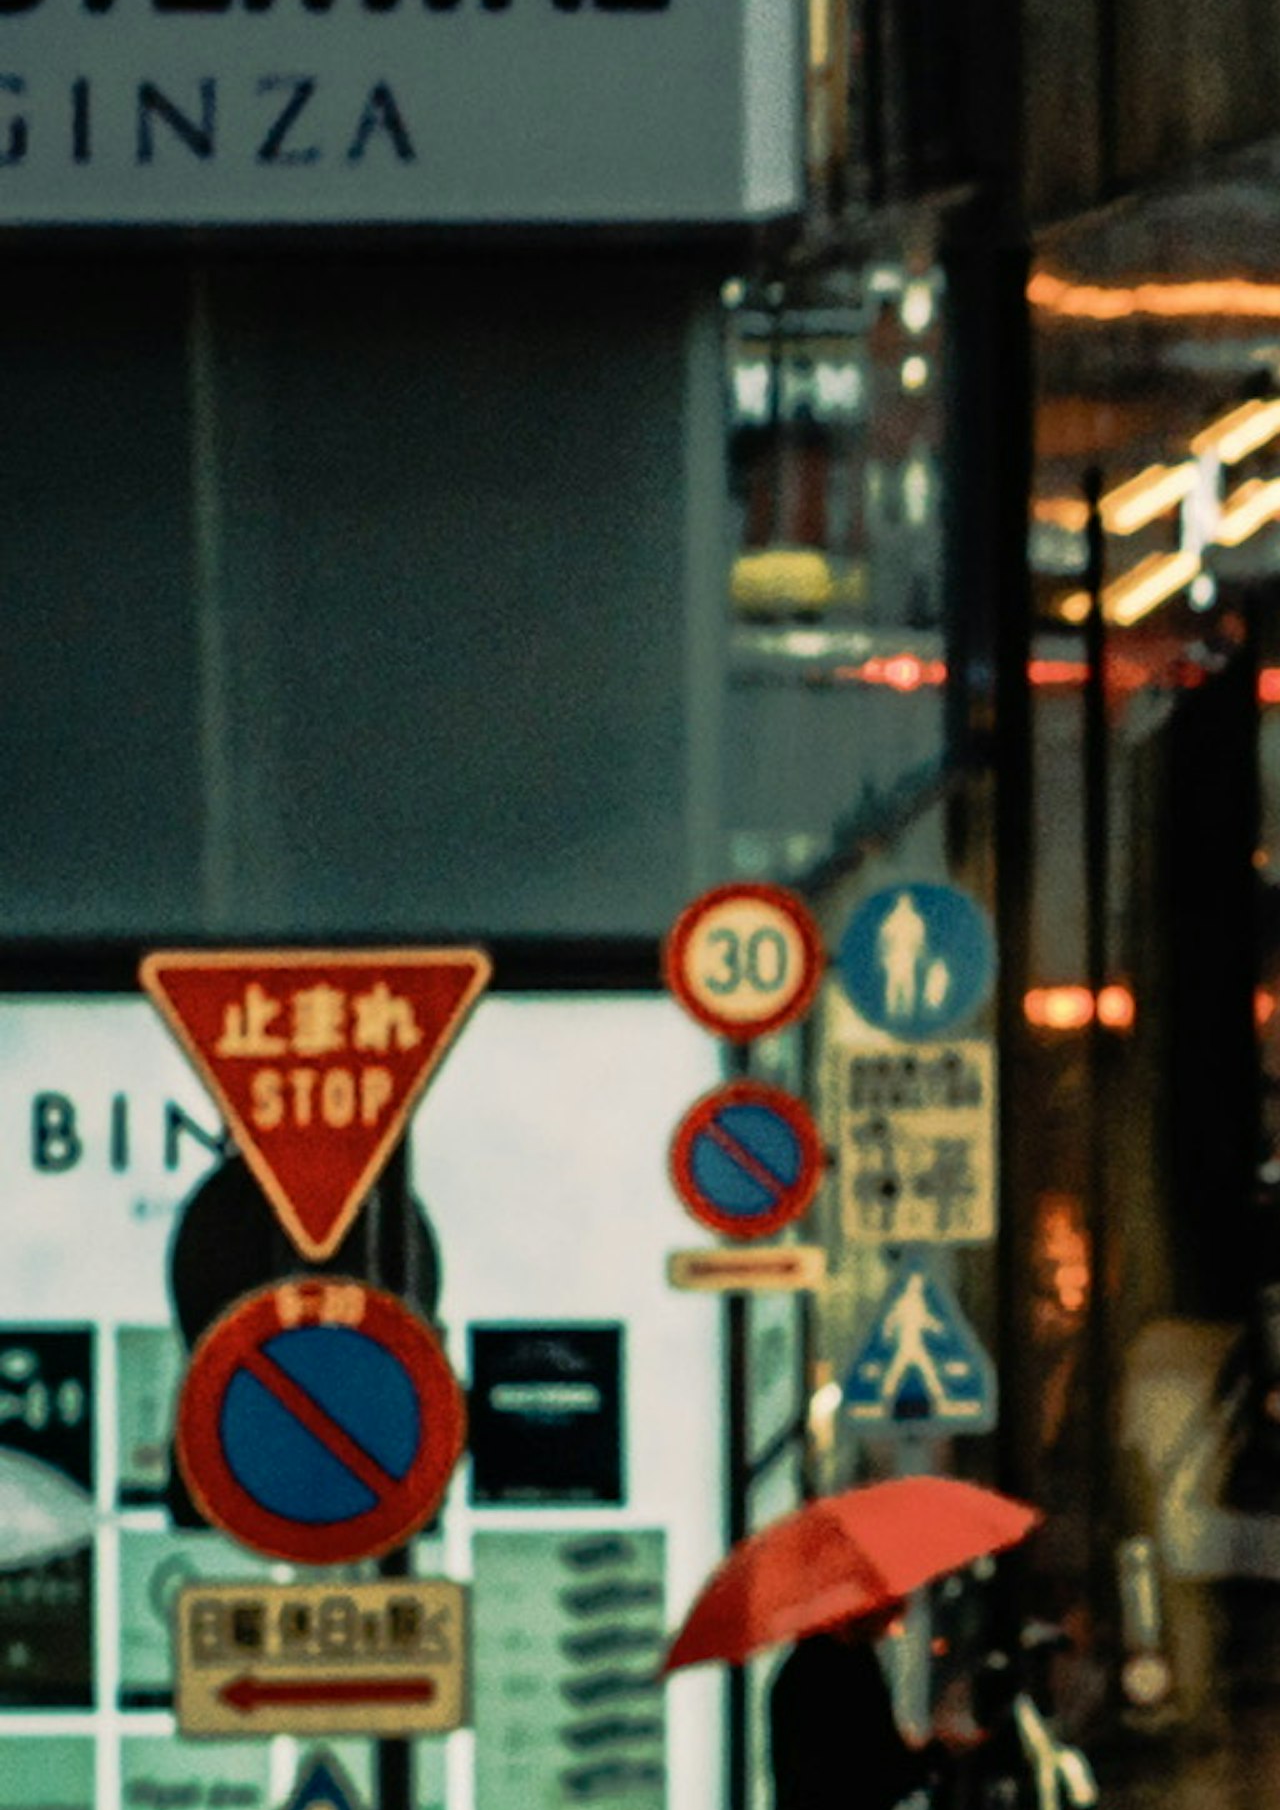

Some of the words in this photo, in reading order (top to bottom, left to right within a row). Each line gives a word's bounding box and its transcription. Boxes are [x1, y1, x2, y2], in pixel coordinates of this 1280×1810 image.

[703, 926, 789, 996] 30
[216, 980, 424, 1060] 止まれ
[250, 1064, 394, 1131] STOP
